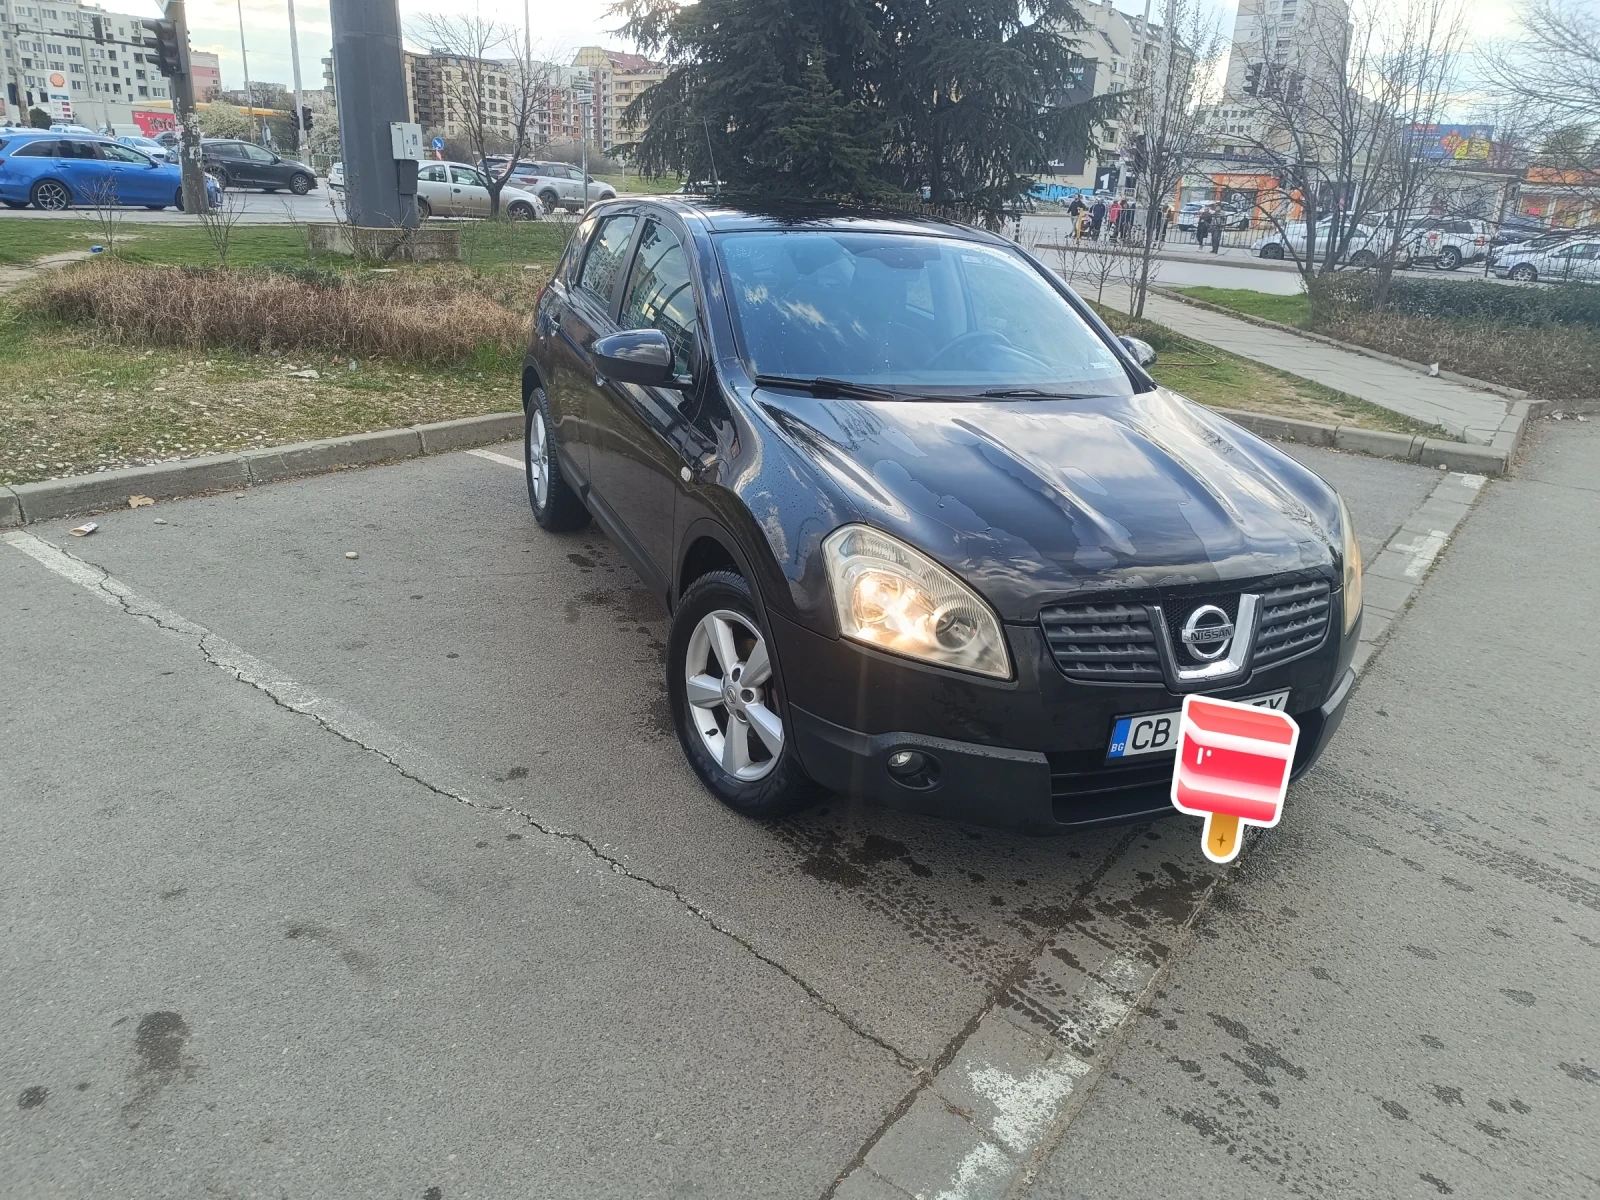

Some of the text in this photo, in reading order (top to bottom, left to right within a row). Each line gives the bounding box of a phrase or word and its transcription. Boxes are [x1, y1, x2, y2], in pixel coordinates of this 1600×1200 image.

[1190, 628, 1232, 641] NISSAN
[1131, 717, 1172, 750] CB
[1110, 742, 1125, 753] BG
